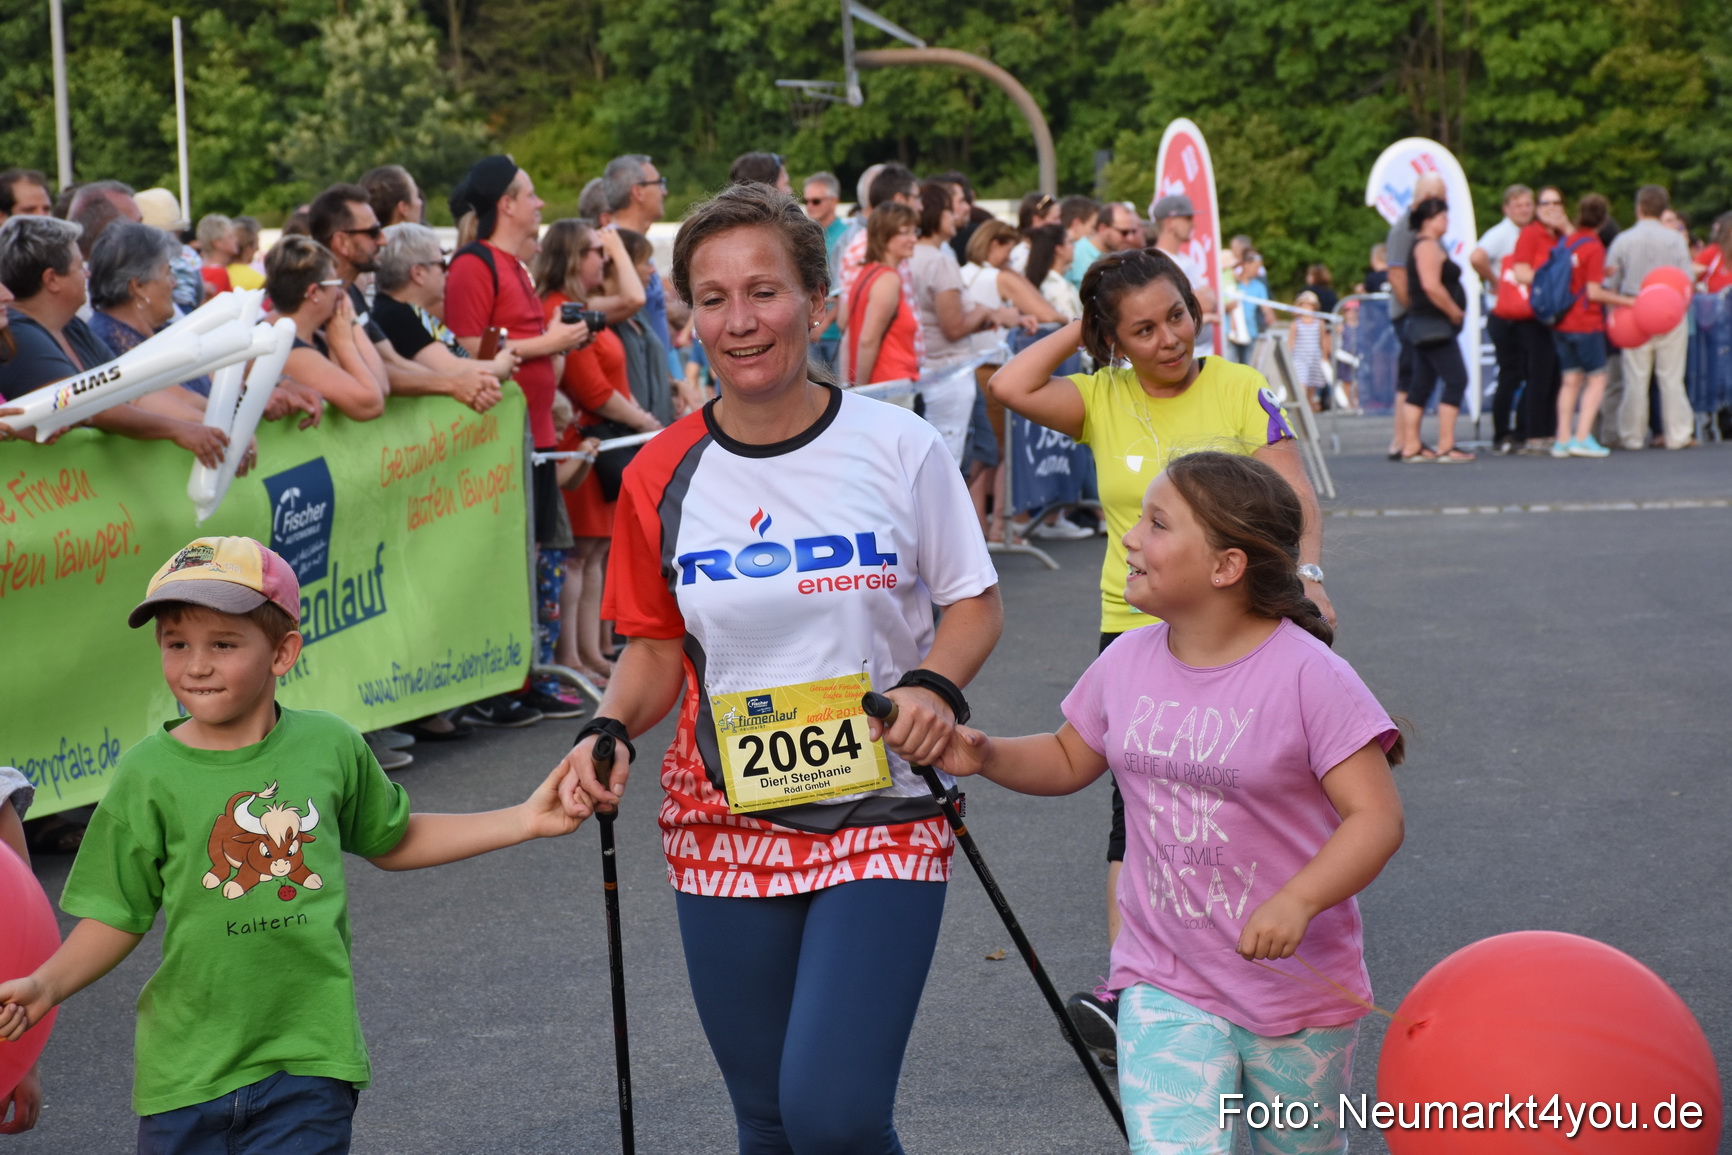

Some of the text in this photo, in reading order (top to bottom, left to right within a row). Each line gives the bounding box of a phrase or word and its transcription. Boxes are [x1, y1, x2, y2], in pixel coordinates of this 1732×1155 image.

[381, 413, 499, 488] Gesunde Firmen
[7, 467, 97, 519] Firmen
[459, 446, 517, 514] länger!
[282, 502, 327, 534] Fischer
[54, 502, 141, 585] länger!
[797, 562, 897, 595] energie
[738, 707, 798, 728] firmenlauf
[806, 707, 834, 724] walk
[1124, 695, 1254, 764] READY
[738, 719, 862, 777] 2064
[760, 764, 852, 789] Dierl Stephanie
[784, 780, 831, 794] Rödl GmbH
[1124, 753, 1240, 789] SELFIE IN PARADISE
[1149, 778, 1230, 844] FOR
[707, 832, 794, 868] AVIA
[803, 825, 899, 866] AVIA
[1183, 846, 1226, 867] SMILE
[226, 912, 308, 936] Kaltern
